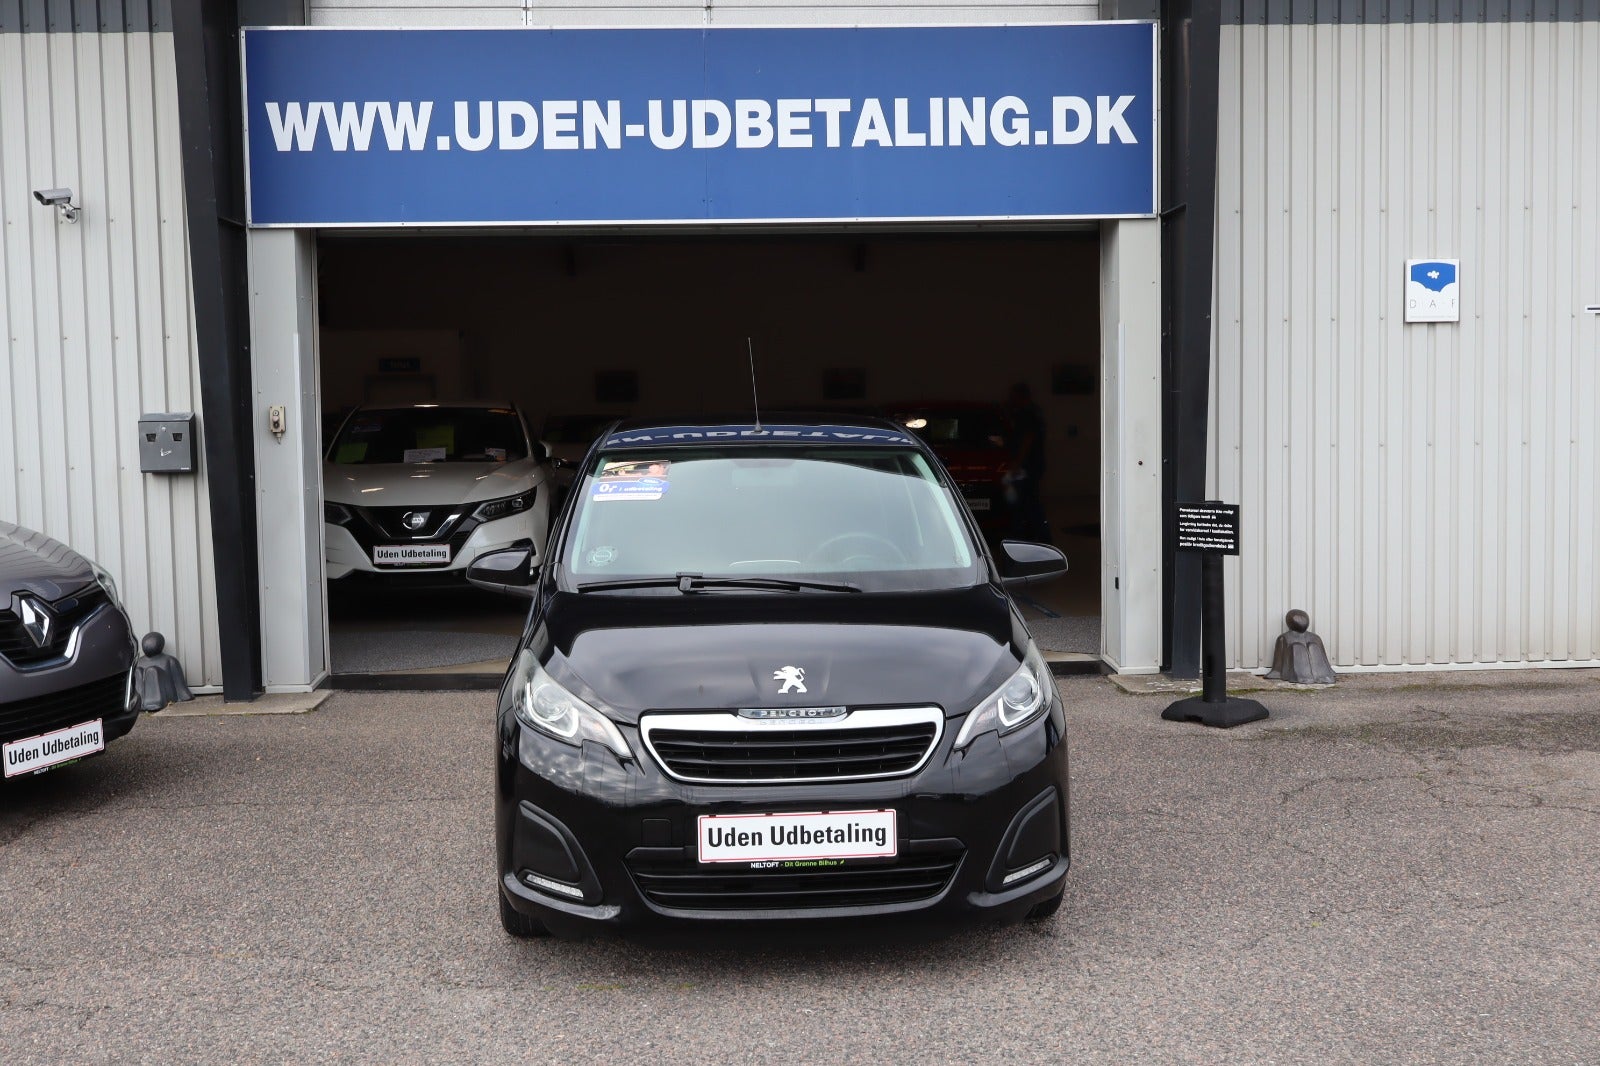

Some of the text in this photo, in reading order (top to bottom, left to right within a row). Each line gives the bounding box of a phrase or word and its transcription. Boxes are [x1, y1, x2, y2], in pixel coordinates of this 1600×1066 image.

[264, 95, 1139, 152] WWW.UDEN-UDBETALING.DK
[377, 548, 447, 559] Uden Udbetaling
[760, 709, 826, 717] PEUGEOT
[9, 748, 39, 766] Uden
[42, 731, 99, 756] Udbetaling
[708, 822, 887, 847] Uden Udbetaling
[751, 861, 779, 869] NELTOFT
